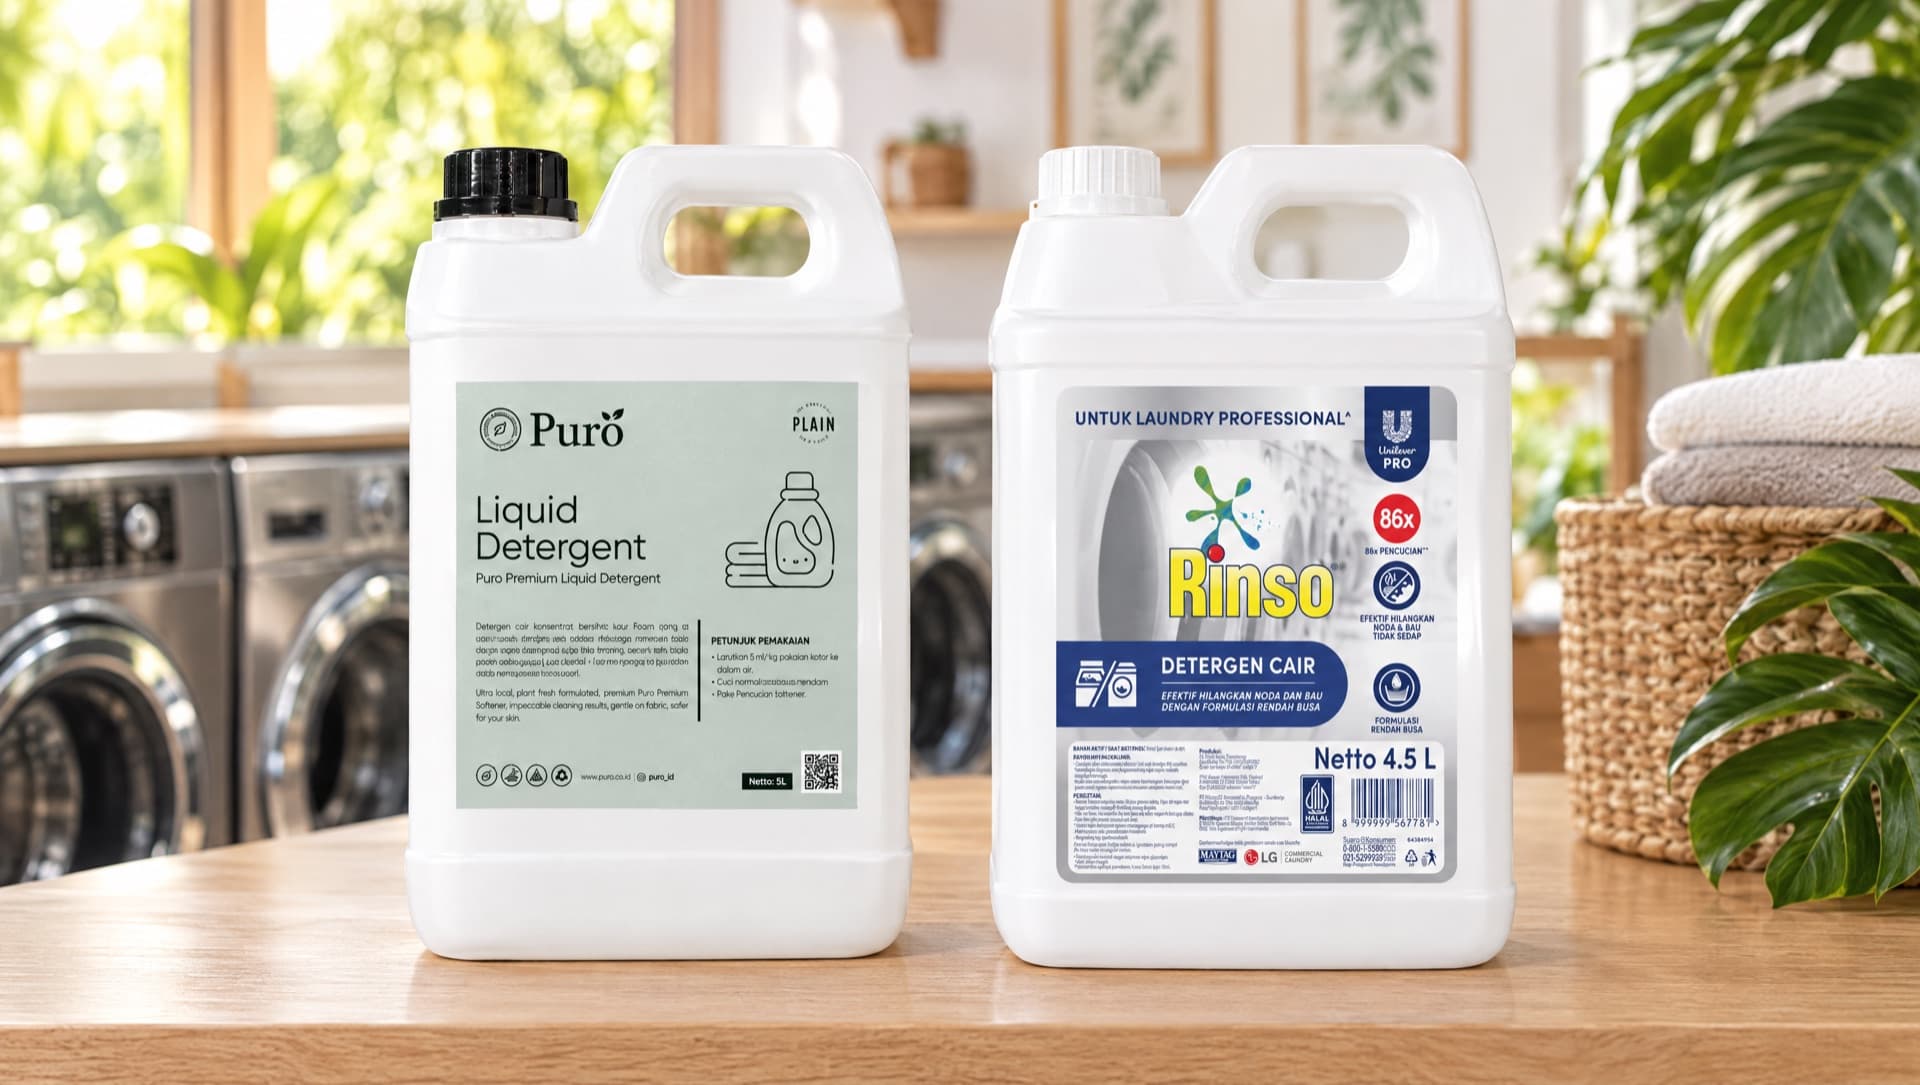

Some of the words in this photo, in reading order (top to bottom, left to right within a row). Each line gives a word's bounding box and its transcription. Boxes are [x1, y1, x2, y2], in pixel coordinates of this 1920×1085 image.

[793, 416, 835, 432] PLAIN
[1075, 411, 1132, 426] UNTUK
[1137, 411, 1214, 426] LAUNDRY
[530, 408, 626, 447] Puro
[1378, 445, 1417, 455] Unilever
[1383, 457, 1411, 469] PRO
[476, 495, 577, 530] Liquid
[1379, 508, 1415, 528] 86x
[476, 532, 647, 568] Detergent
[1364, 547, 1378, 555] 86x
[476, 572, 503, 584] Puro
[506, 572, 558, 584] Premium
[561, 572, 597, 587] Liquid
[600, 572, 661, 587] Detergent
[1169, 544, 1334, 619] Rinso
[1373, 624, 1396, 632] NODA
[1397, 624, 1403, 632] &
[1405, 624, 1421, 632] BAU
[712, 636, 757, 645] PETUNJUK
[759, 636, 811, 645] PEMAKAIAN
[1373, 632, 1395, 640] TIDAK
[1397, 632, 1422, 640] SEDAP
[1161, 657, 1266, 675] DETERGEN
[1270, 657, 1315, 675] CAIR
[475, 689, 494, 697] Ultra
[517, 688, 536, 699] plant
[539, 688, 556, 697] fresh
[604, 689, 636, 698] premium
[657, 689, 689, 697] Premium
[1161, 692, 1197, 700] EFEKTIF
[1198, 692, 1252, 700] HILANGKAN
[1254, 692, 1281, 700] NODA
[1283, 692, 1303, 700] DAN
[1304, 692, 1323, 700] BAU
[1161, 703, 1200, 711] DENGAN
[1202, 703, 1255, 711] FORMULASI
[1256, 703, 1295, 711] RENDAH
[1297, 703, 1321, 711] BUSA
[1375, 717, 1419, 725] FORMULASI
[1371, 726, 1402, 734] RENDAH
[1404, 726, 1423, 734] BUSA
[1315, 747, 1376, 769] Netto
[1383, 747, 1417, 769] 4.5
[1425, 747, 1436, 769] L
[649, 772, 675, 782] puro_id
[749, 777, 775, 786] Netto:
[777, 777, 787, 786] 5L
[1200, 850, 1235, 859] MAYTAG
[1261, 851, 1278, 863] LG
